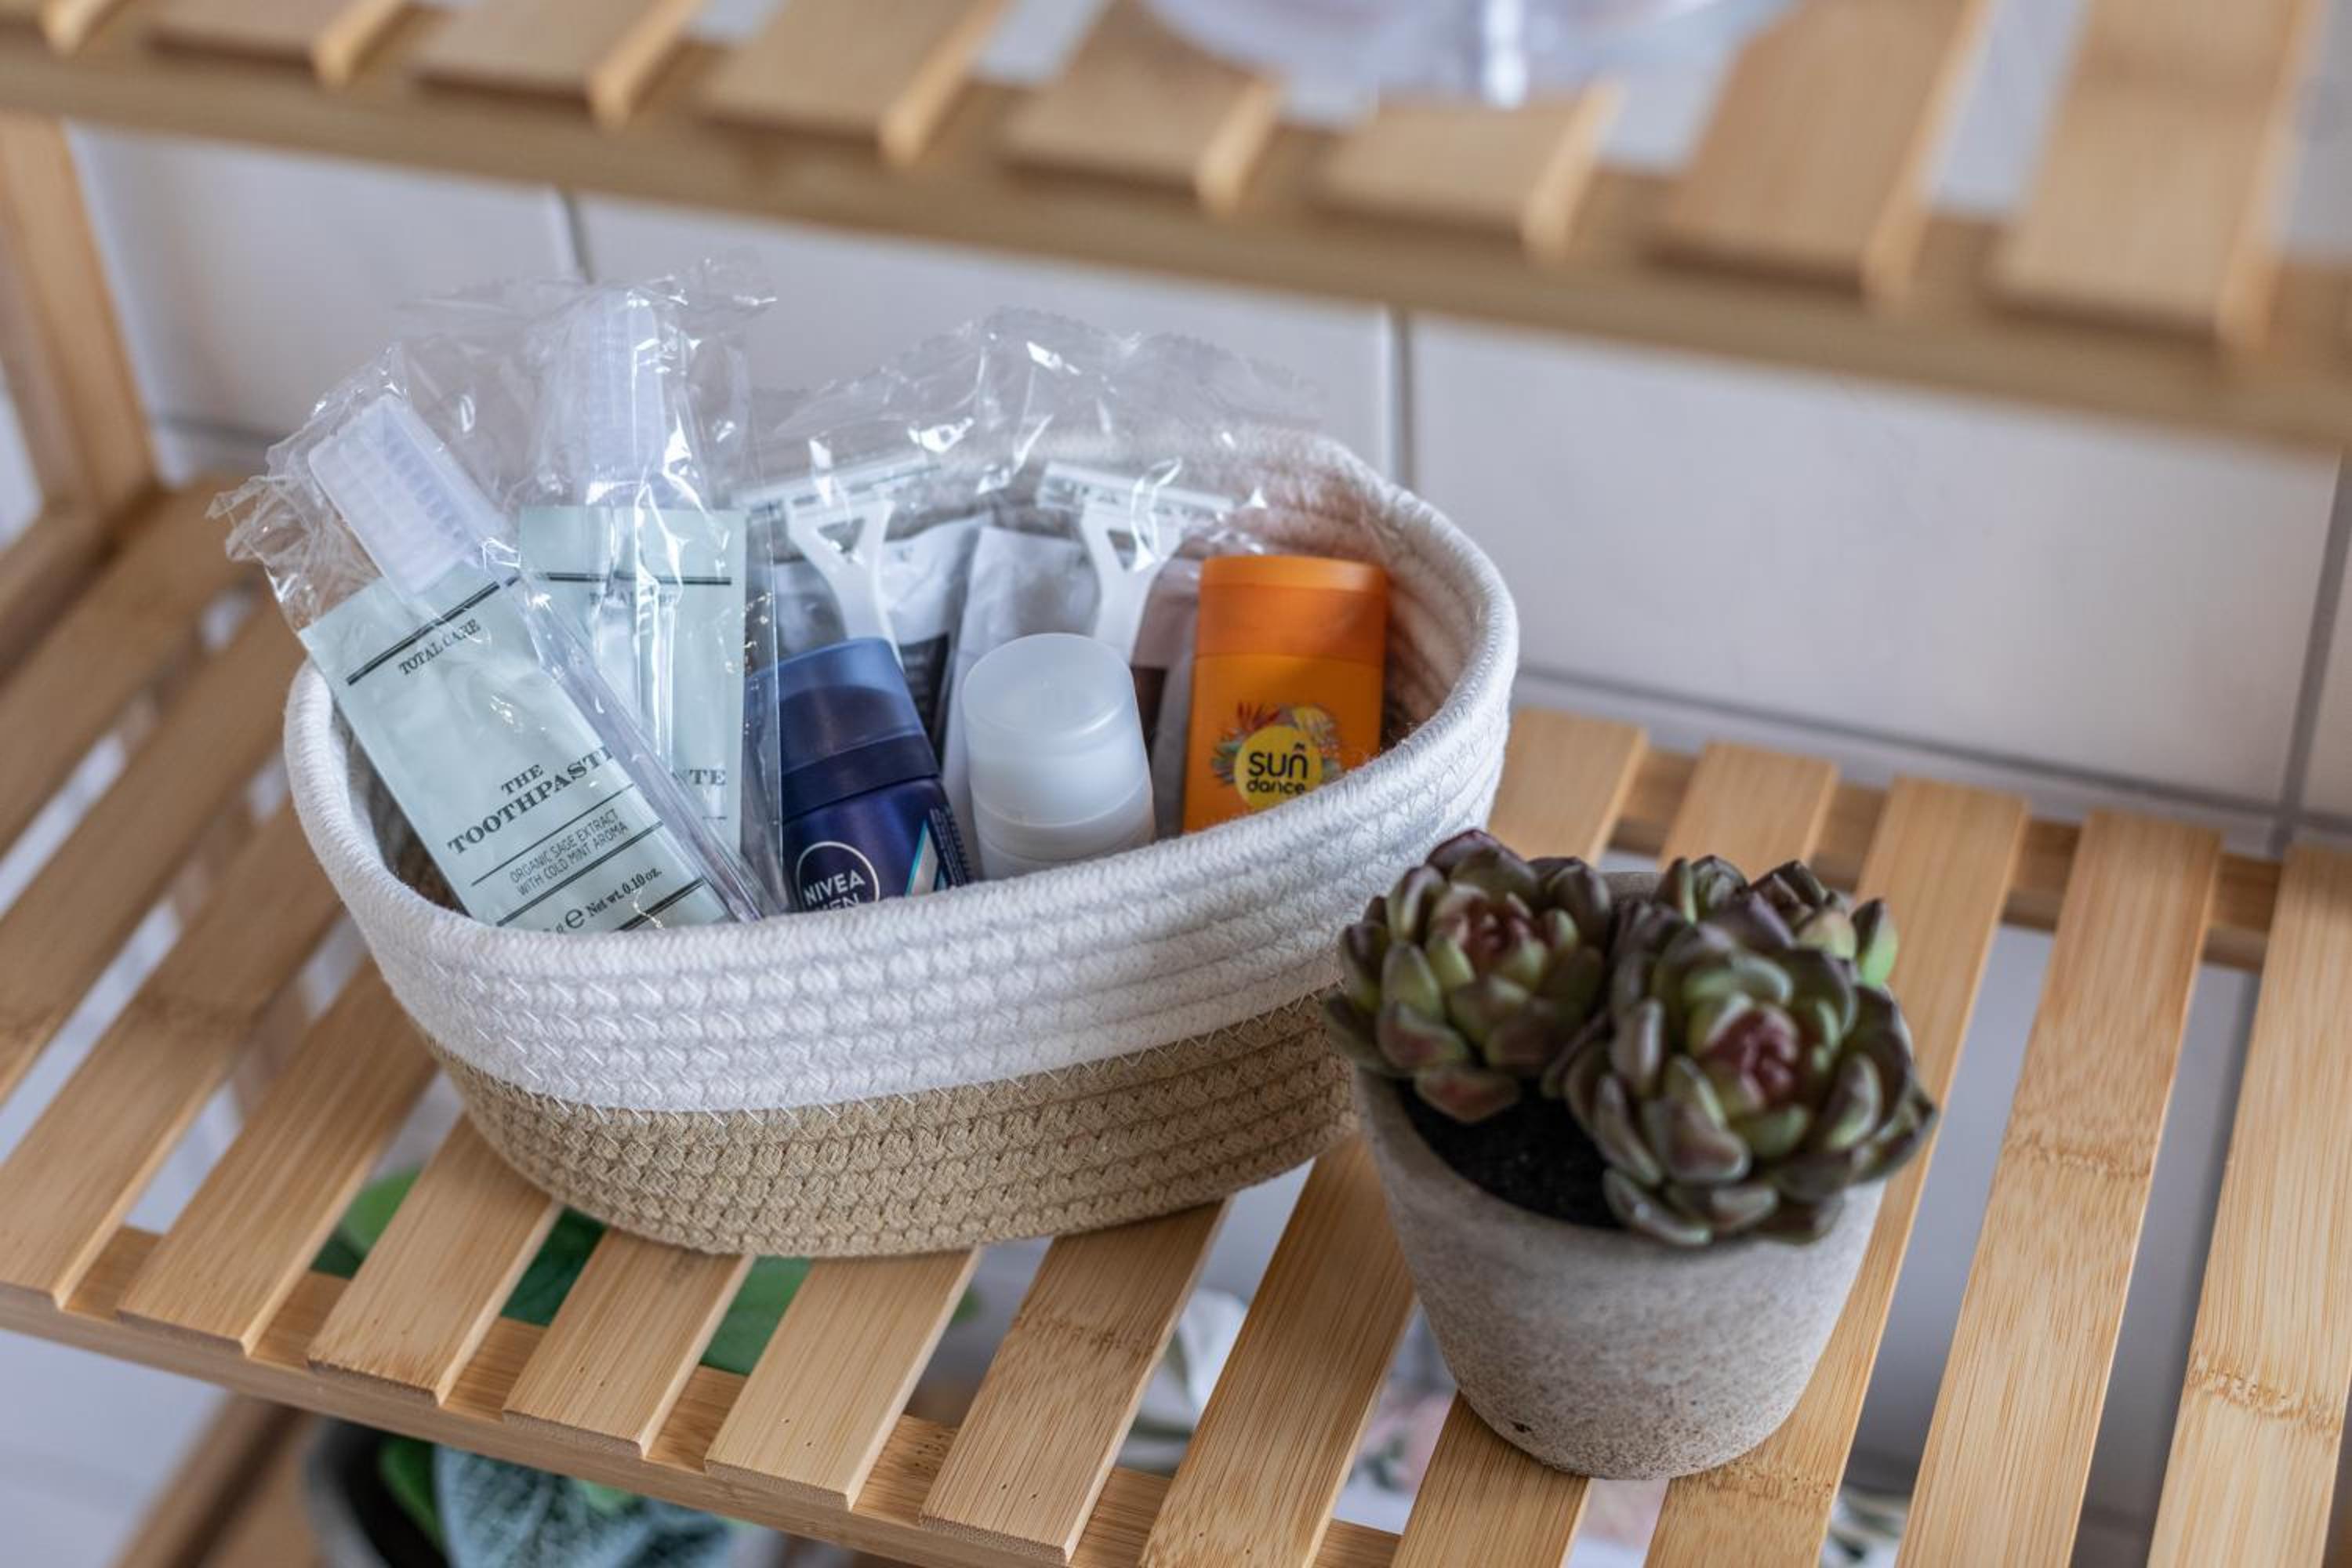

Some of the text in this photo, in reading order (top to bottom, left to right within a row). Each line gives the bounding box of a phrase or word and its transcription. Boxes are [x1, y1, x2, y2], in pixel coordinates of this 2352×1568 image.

[398, 619, 482, 675] TOTAL CARE
[501, 764, 544, 795] THE
[1247, 778, 1305, 795] dance
[510, 808, 619, 883] ORGANIC SAGE EXTRACT
[517, 821, 628, 896] WITH COLD MINT AROMA
[586, 897, 608, 916] Net
[622, 873, 647, 895] 0.10
[804, 869, 866, 906] NIVEA
